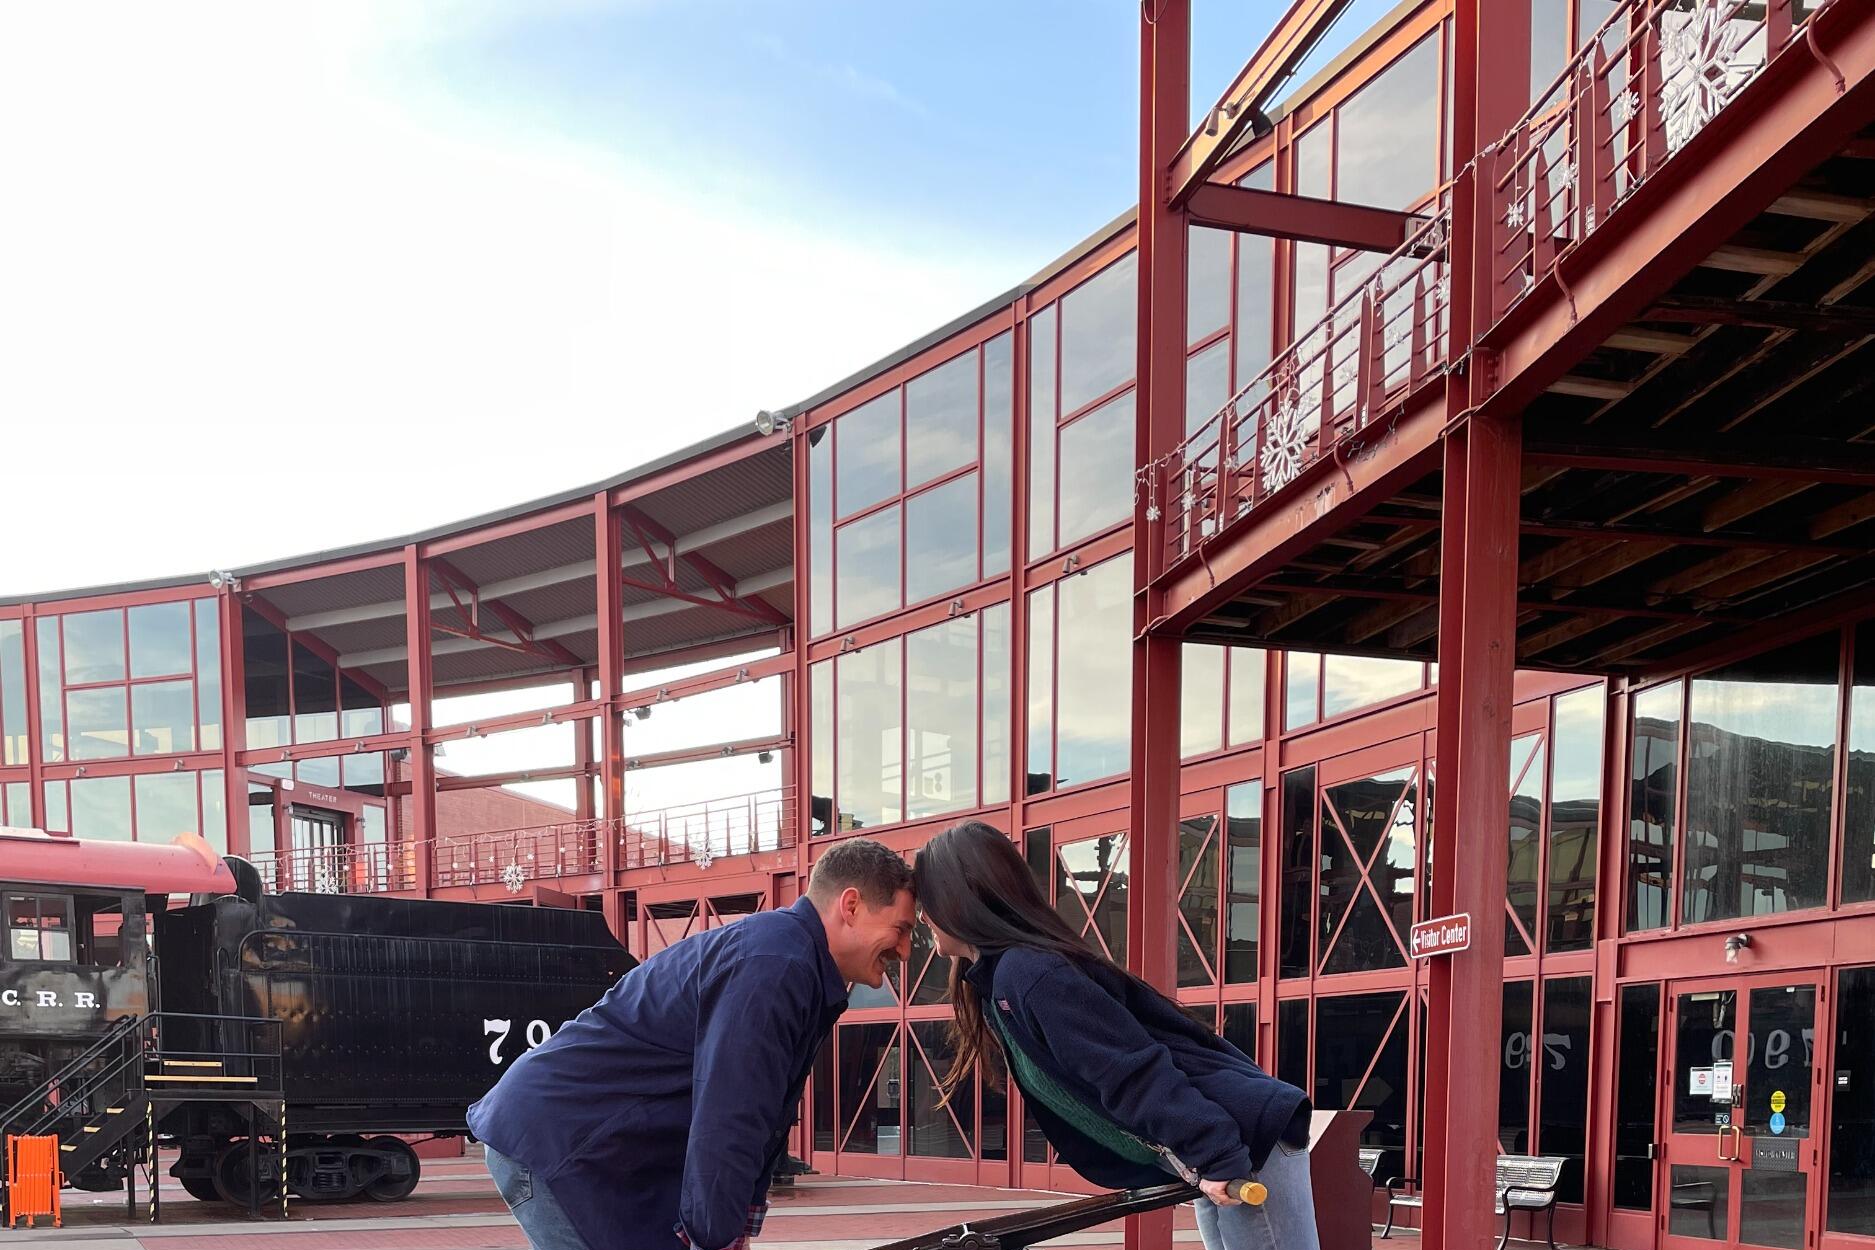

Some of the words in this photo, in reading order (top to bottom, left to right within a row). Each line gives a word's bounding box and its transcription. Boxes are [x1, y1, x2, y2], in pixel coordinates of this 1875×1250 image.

[309, 791, 337, 803] THEATER
[1421, 928, 1440, 949] Visitor
[1441, 923, 1467, 945] Center
[36, 991, 63, 1007] R.
[74, 992, 101, 1008] R.
